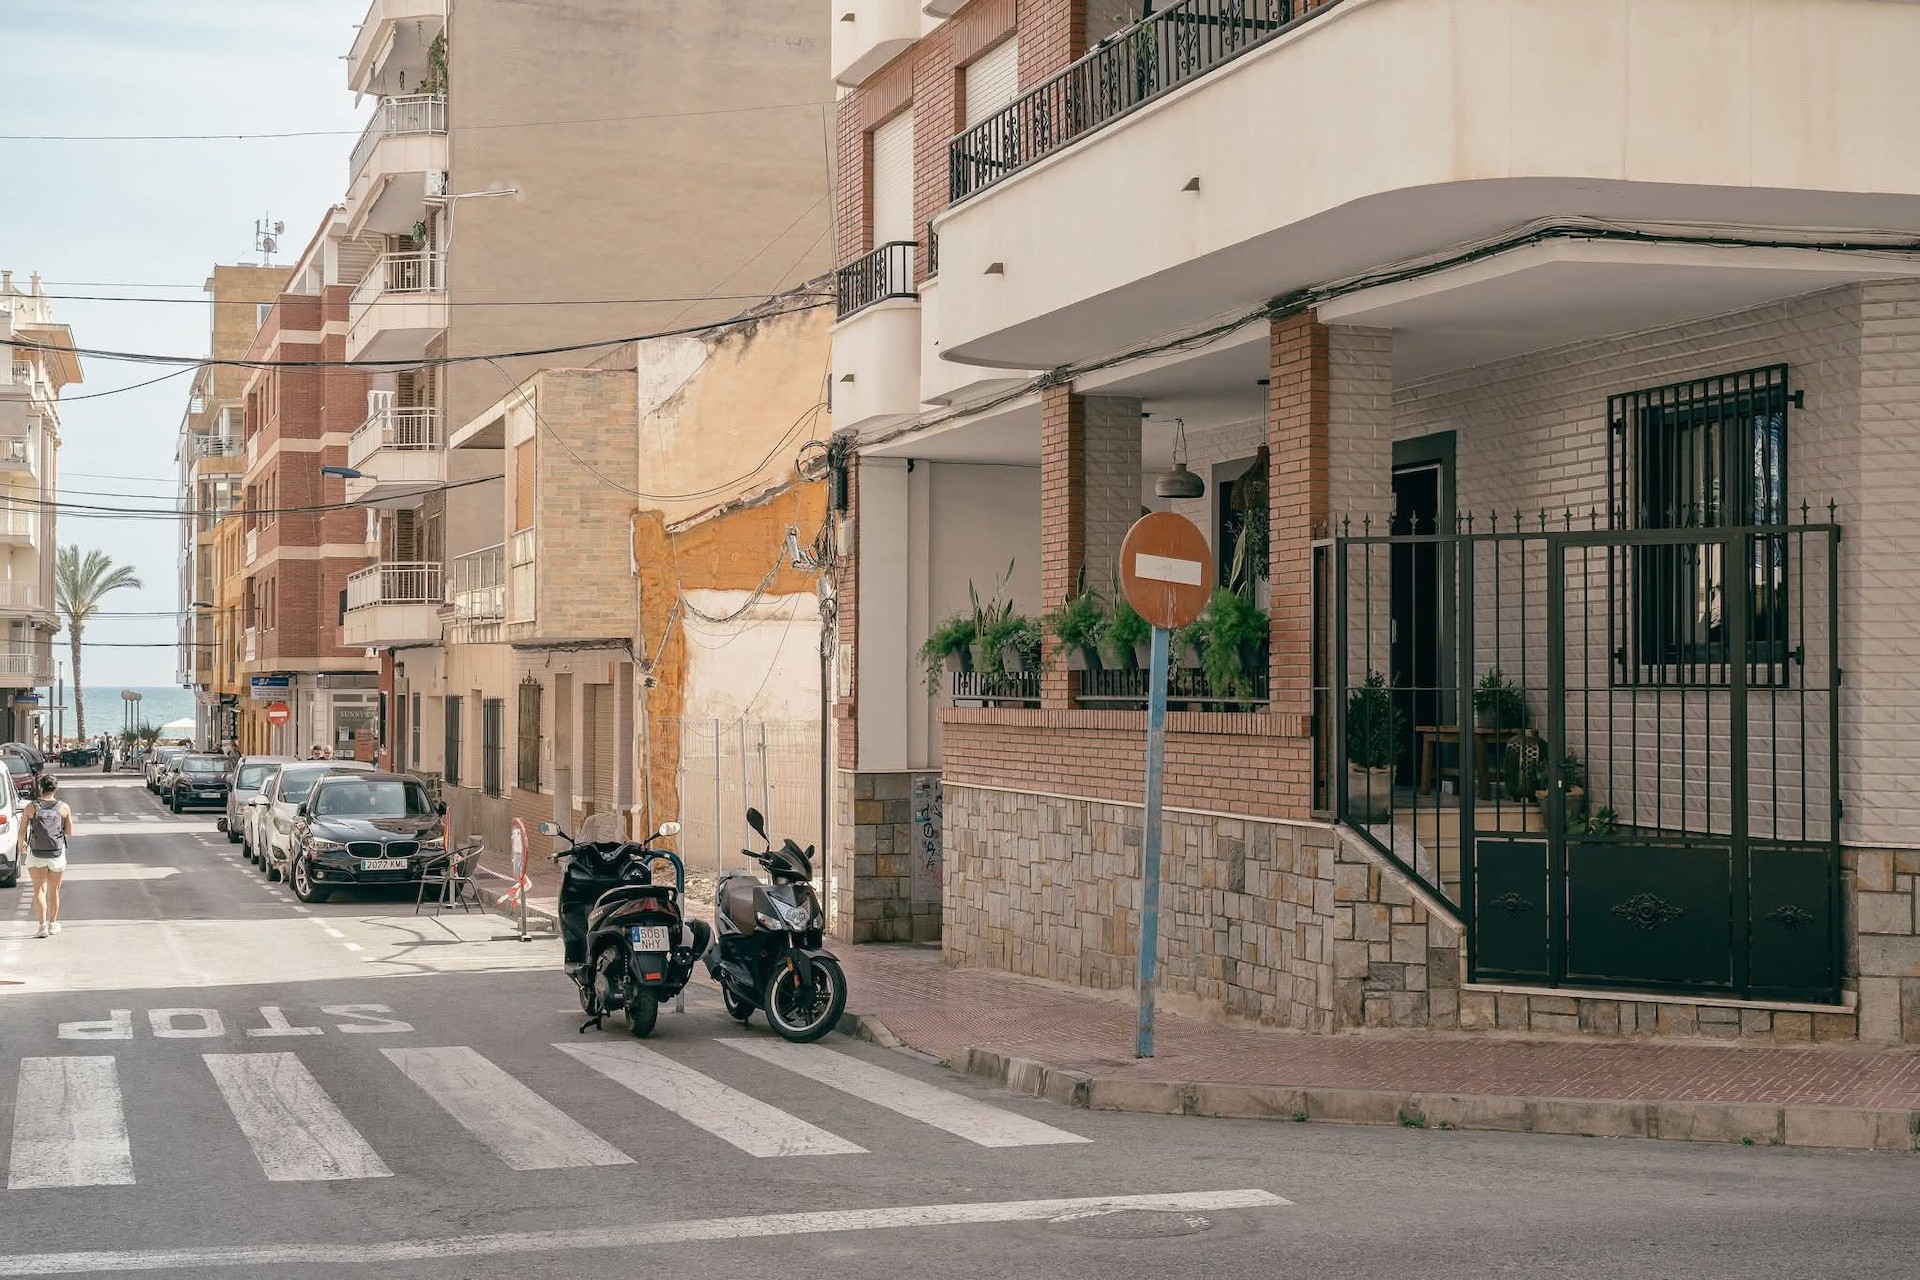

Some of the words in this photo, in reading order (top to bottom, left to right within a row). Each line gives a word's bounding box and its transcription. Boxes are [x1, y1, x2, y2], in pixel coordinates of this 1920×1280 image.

[340, 710, 364, 718] SUNNY
[367, 860, 388, 869] 2077
[390, 860, 406, 868] KML
[640, 928, 666, 939] 5061
[641, 939, 661, 950] NHY
[57, 1003, 416, 1040] STOP
